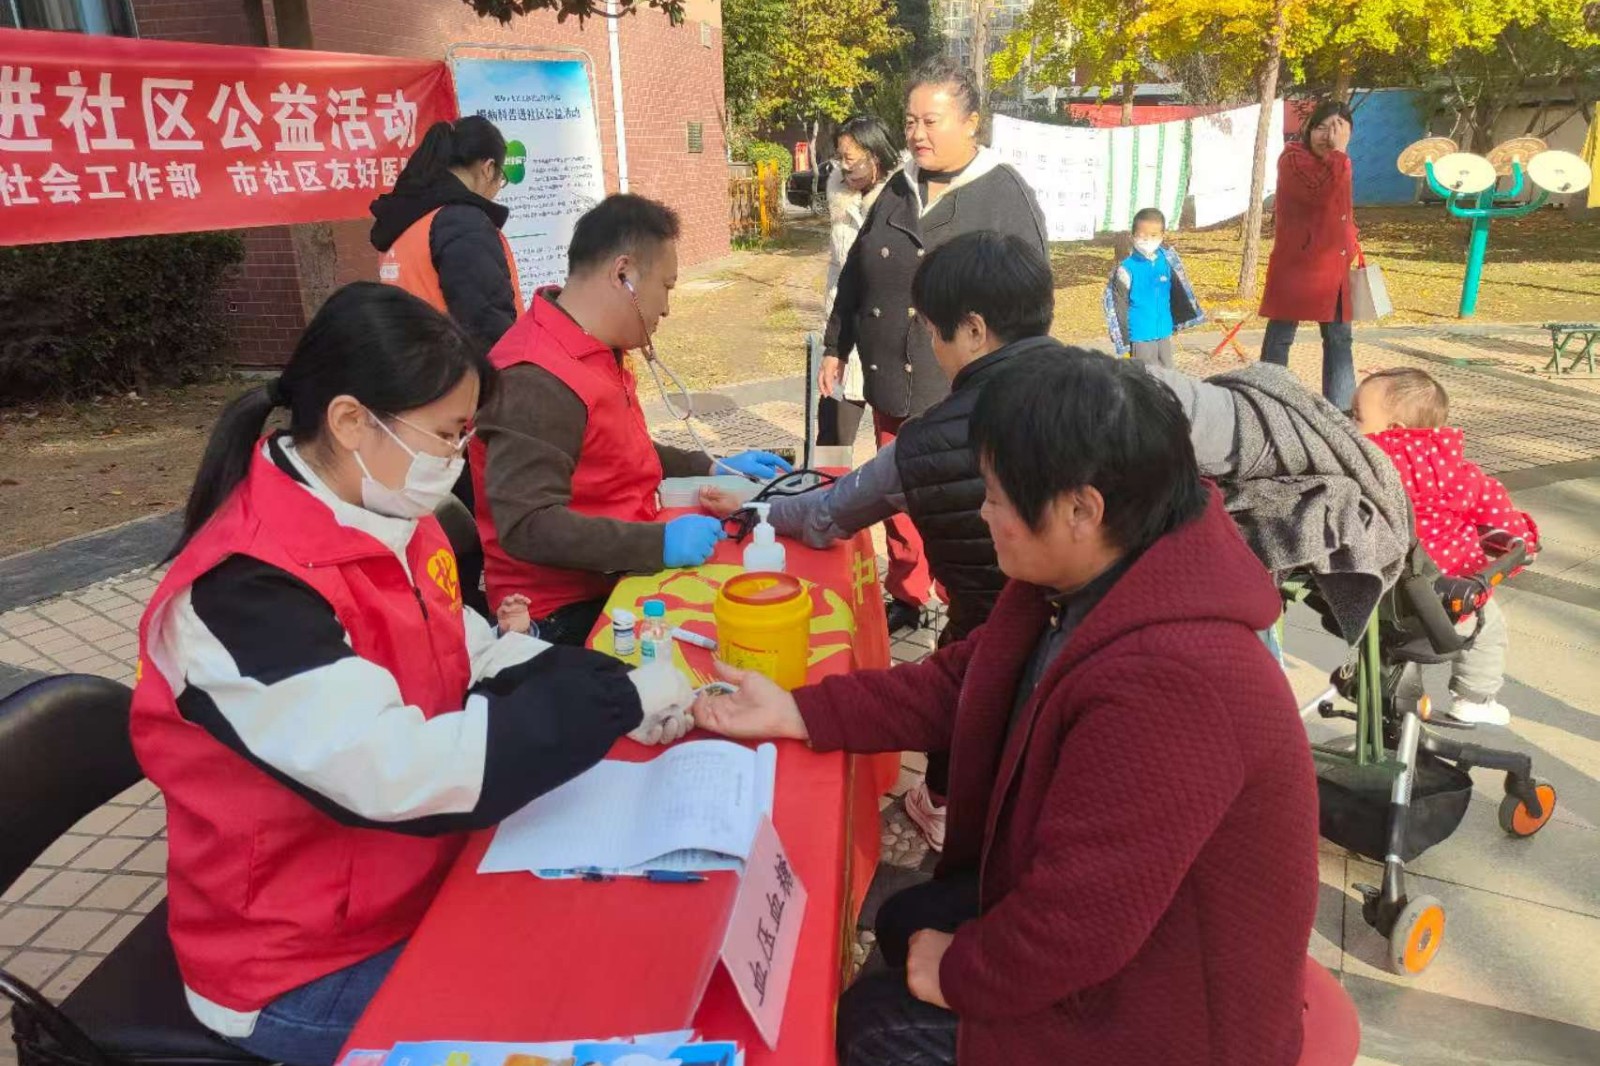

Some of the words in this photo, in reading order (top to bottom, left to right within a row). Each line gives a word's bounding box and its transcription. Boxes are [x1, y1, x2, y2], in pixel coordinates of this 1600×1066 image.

[0, 65, 418, 154] 进社区公益活动
[0, 160, 201, 207] 社会工作部
[226, 156, 410, 197] 市社区友好医
